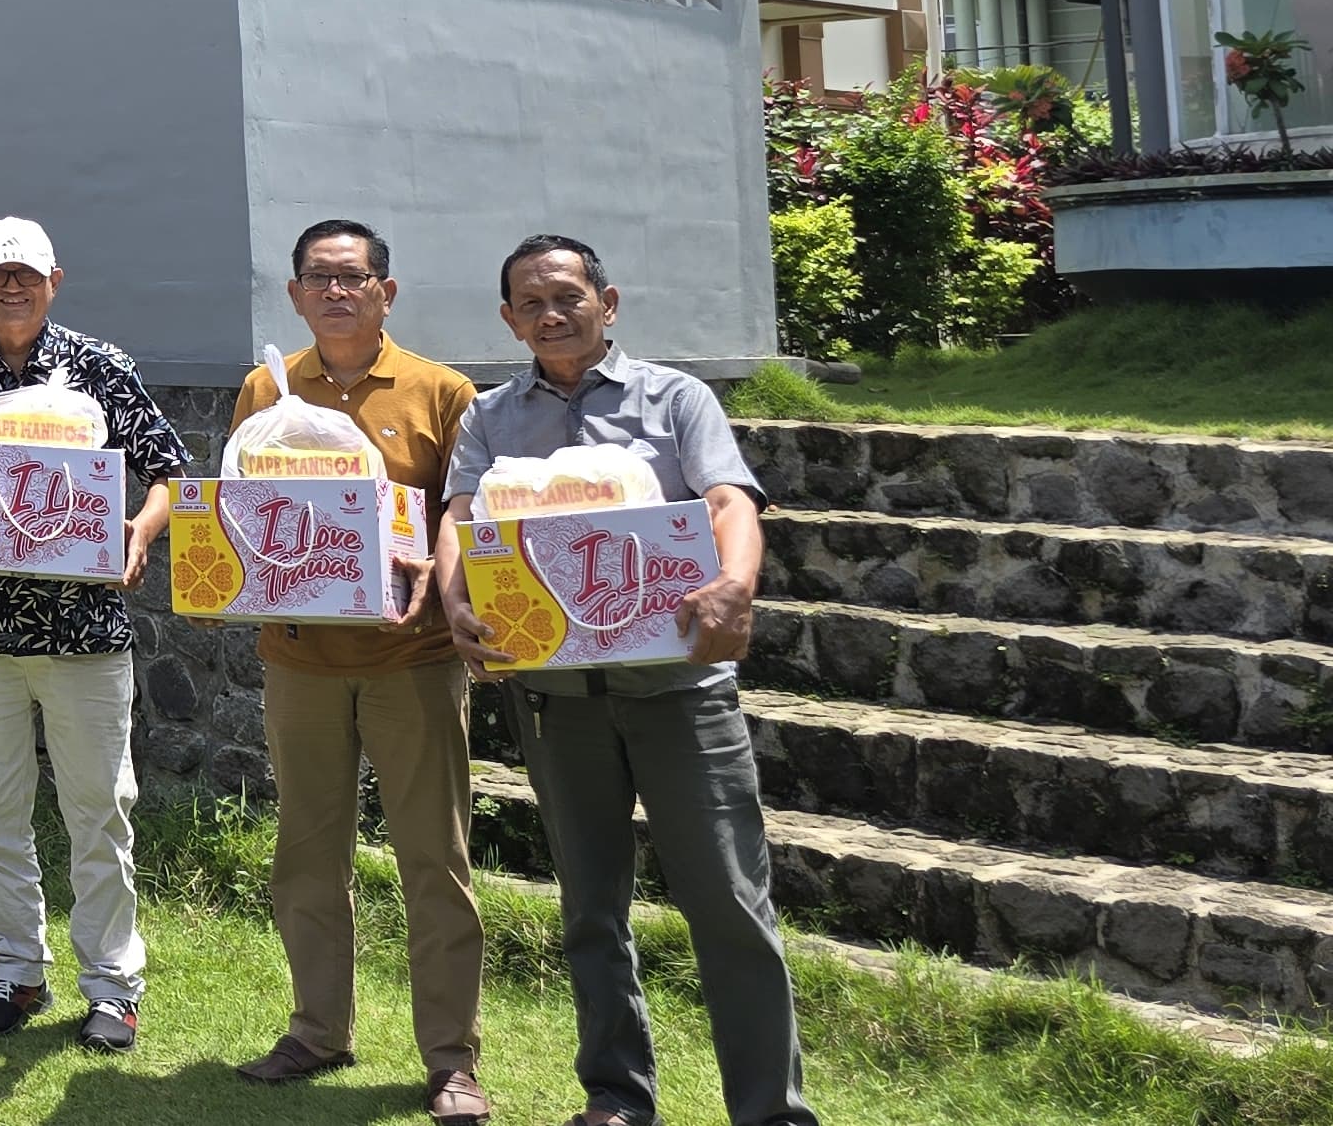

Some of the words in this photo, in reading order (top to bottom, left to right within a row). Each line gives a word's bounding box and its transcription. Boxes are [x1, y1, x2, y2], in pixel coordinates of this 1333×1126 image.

[20, 420, 63, 440] MANIS
[3, 460, 44, 520] I
[40, 471, 110, 517] Love
[247, 455, 282, 475] TAPE
[285, 456, 333, 475] MANIS
[488, 487, 529, 510] TAPE
[5, 514, 109, 562] Trawas
[254, 496, 295, 562] I
[294, 509, 364, 557] Love
[257, 551, 364, 605] Trawas
[569, 529, 612, 606] I
[619, 538, 704, 595] Love
[584, 586, 691, 650] Trawa
